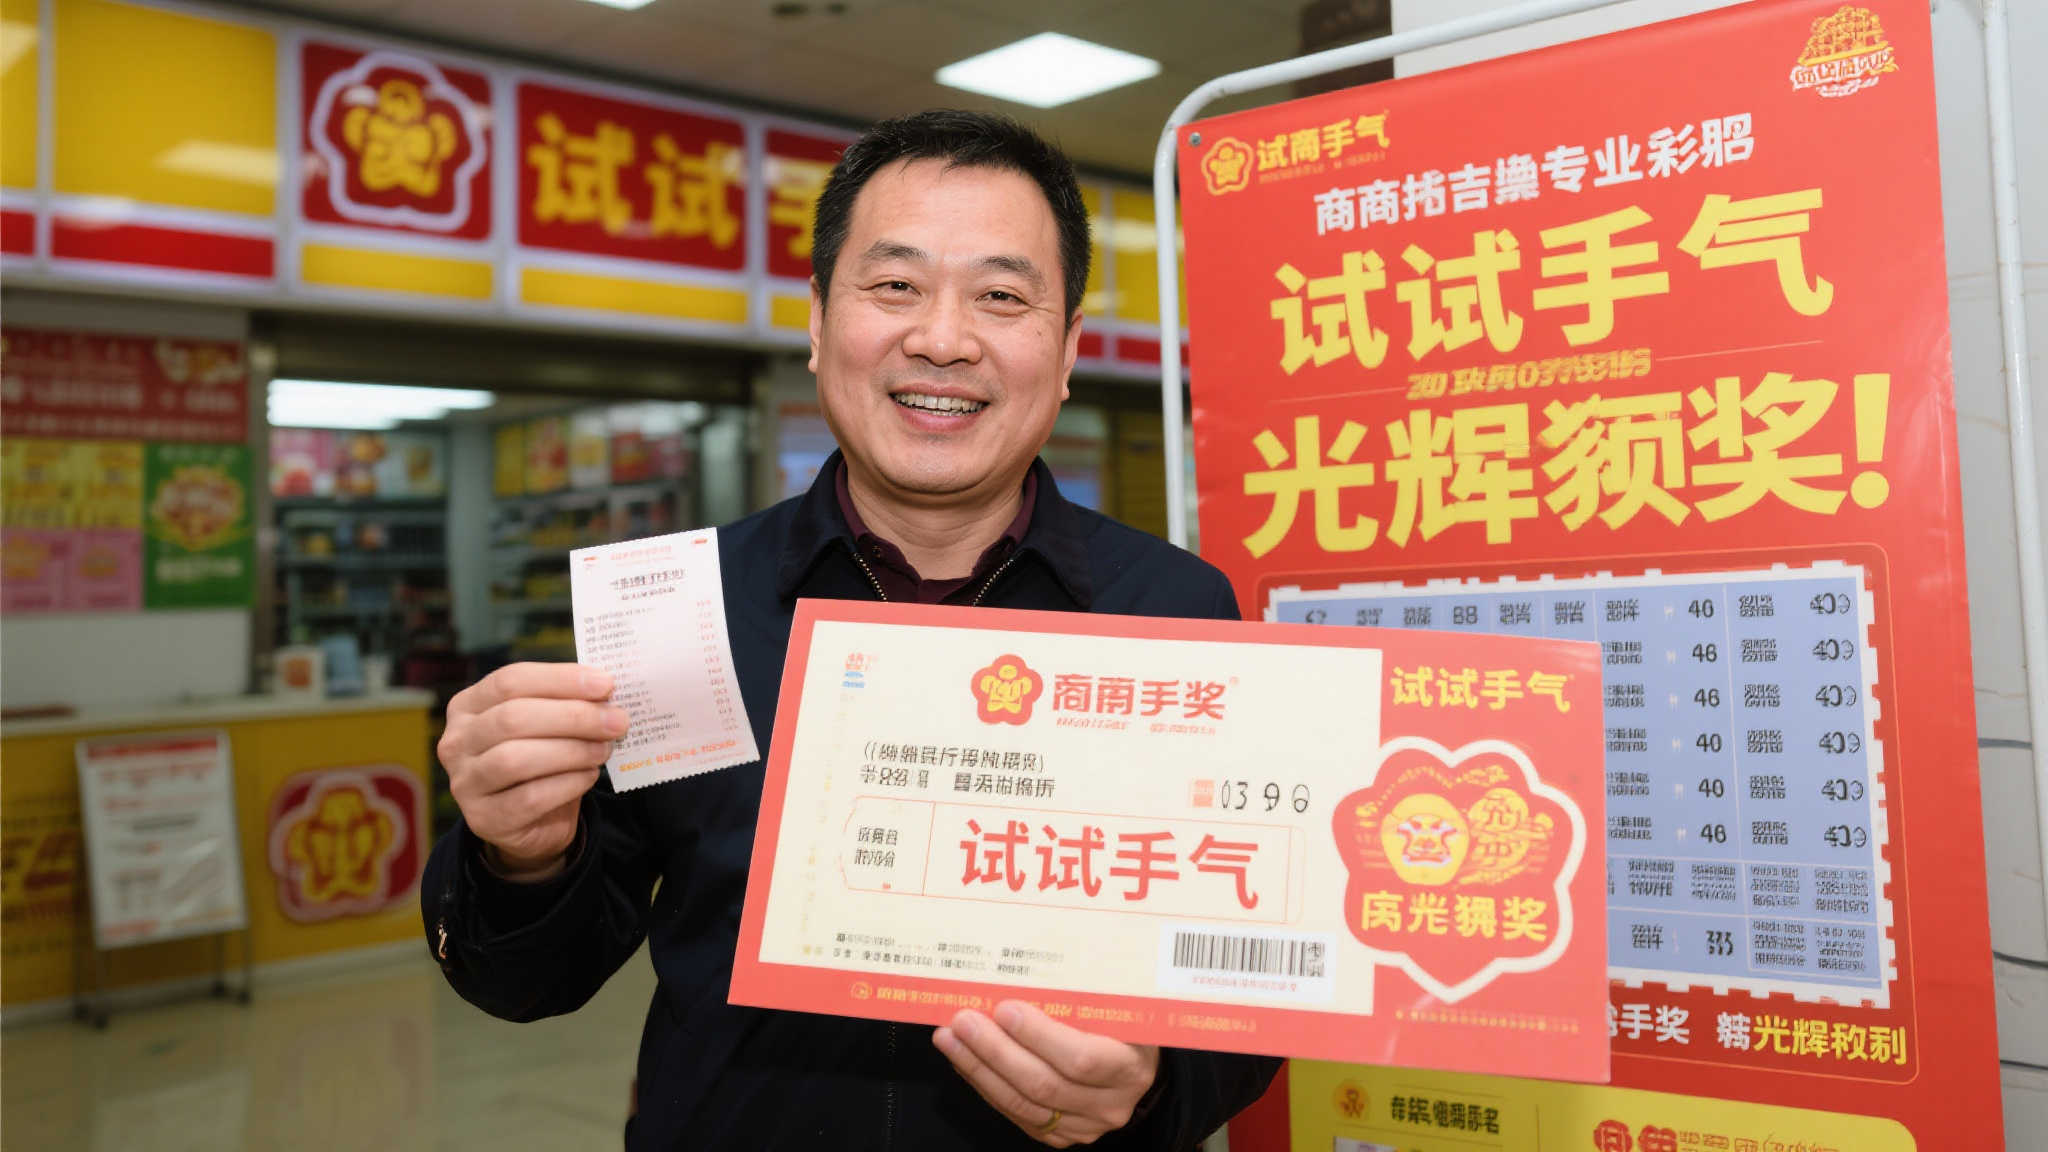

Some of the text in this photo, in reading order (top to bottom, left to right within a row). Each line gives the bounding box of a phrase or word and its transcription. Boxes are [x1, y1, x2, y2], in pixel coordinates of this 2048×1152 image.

[1270, 187, 1835, 375] 试试手气
[1390, 665, 1572, 713] 试试手气
[960, 819, 1259, 910] 试试手气
